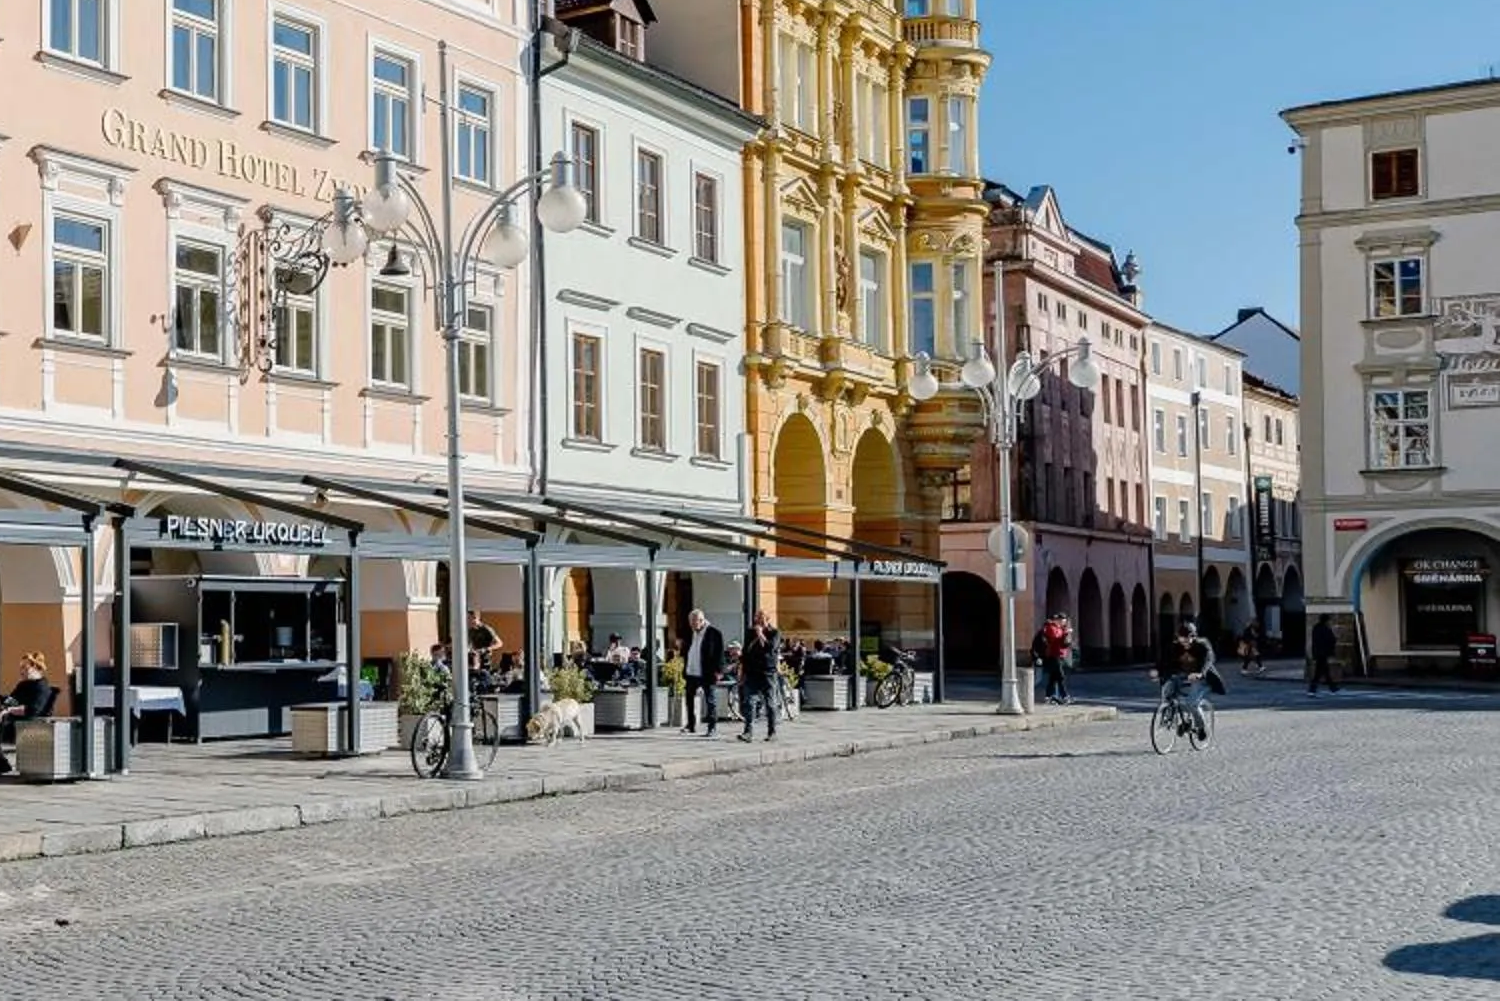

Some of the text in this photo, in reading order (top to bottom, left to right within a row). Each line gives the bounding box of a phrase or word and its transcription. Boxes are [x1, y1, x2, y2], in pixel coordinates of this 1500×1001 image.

[101, 107, 208, 169] GRAND
[217, 139, 306, 198] HOTEL
[167, 515, 332, 544] PILSNER URQUELL
